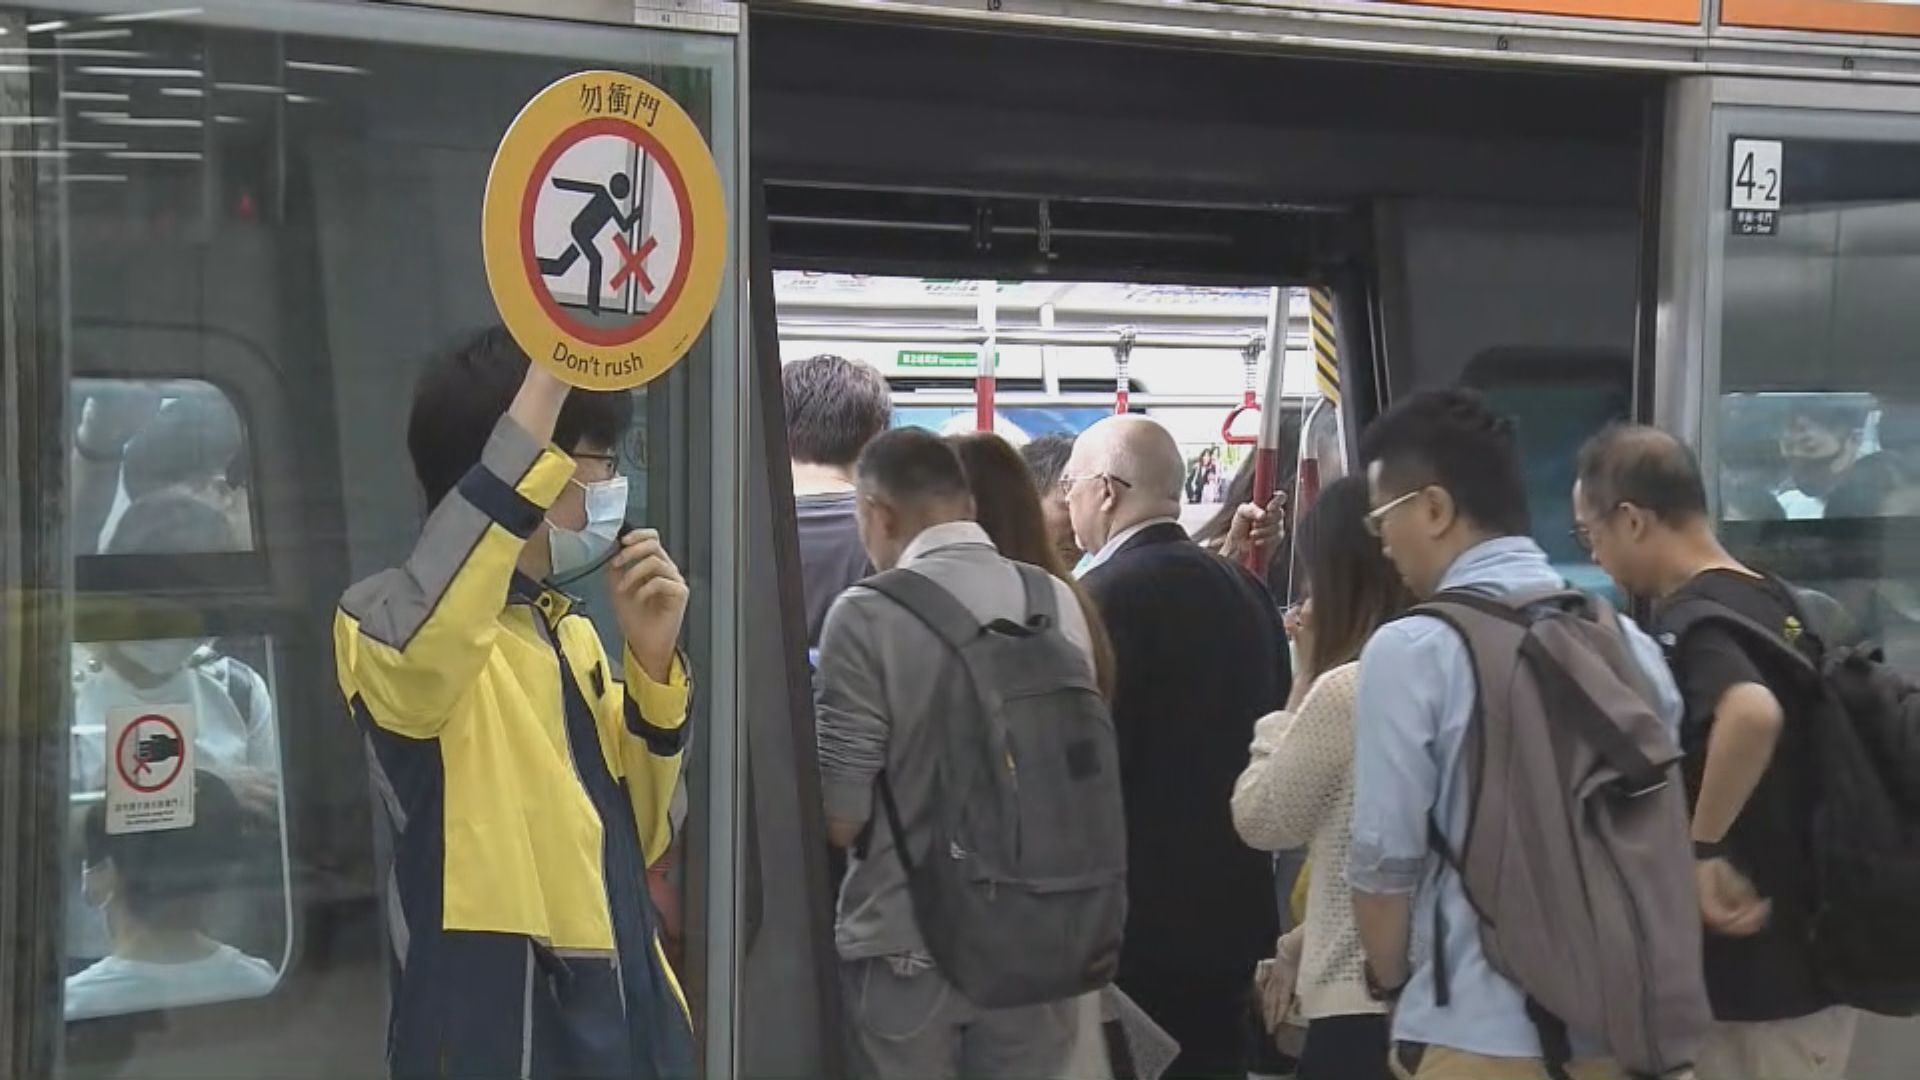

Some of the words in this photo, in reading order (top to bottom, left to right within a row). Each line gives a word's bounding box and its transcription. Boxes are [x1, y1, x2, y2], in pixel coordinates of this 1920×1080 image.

[579, 82, 661, 128] 勿衝門
[1736, 152, 1777, 201] 4-2
[552, 341, 600, 377] Don't
[604, 352, 644, 377] rush
